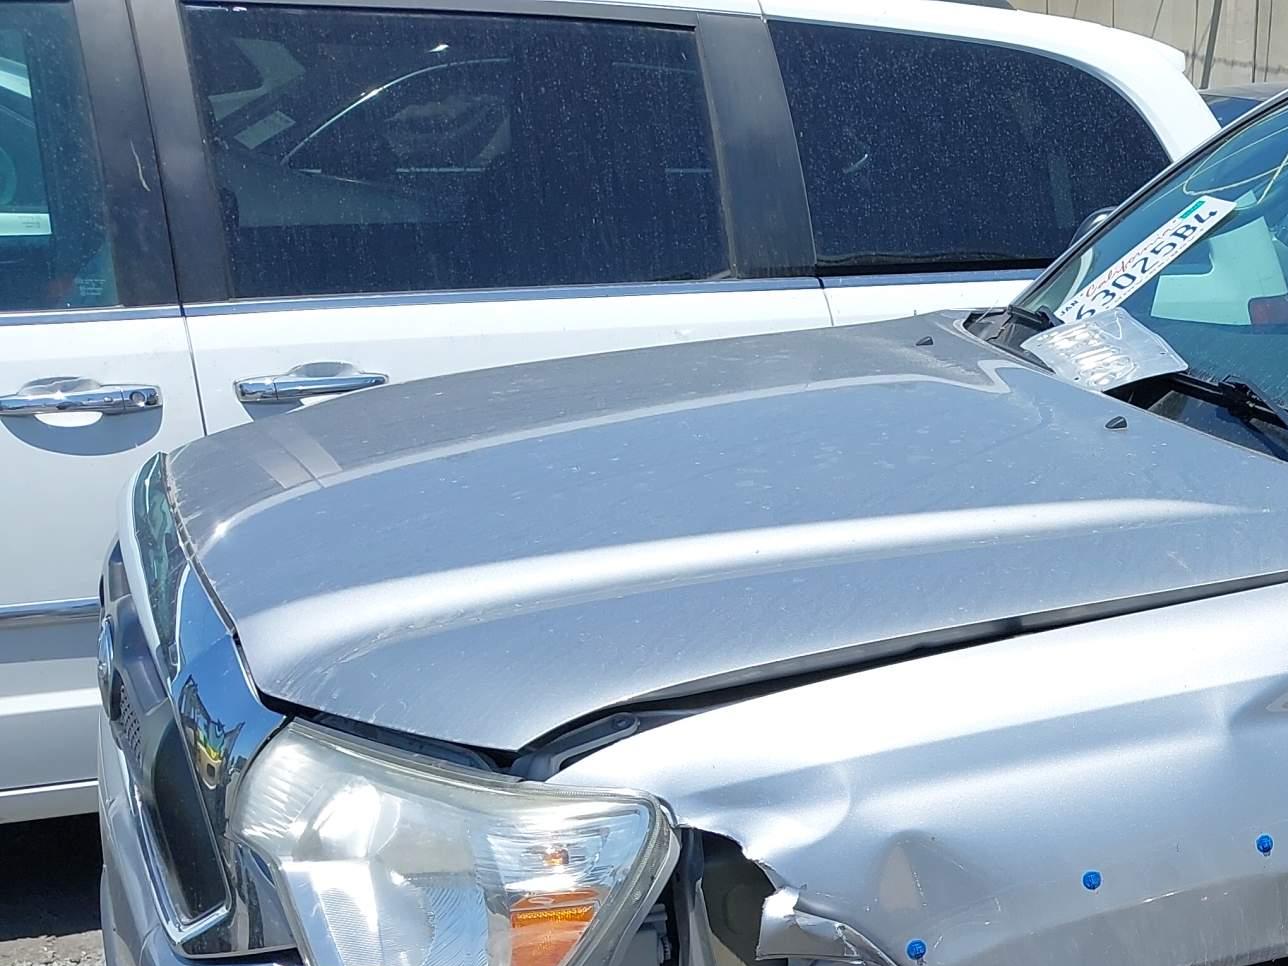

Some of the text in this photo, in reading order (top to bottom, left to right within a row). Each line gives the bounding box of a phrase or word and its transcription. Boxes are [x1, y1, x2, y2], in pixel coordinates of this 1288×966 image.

[1060, 300, 1079, 317] JAN
[1085, 226, 1176, 298] California
[1075, 210, 1219, 321] 63025B4
